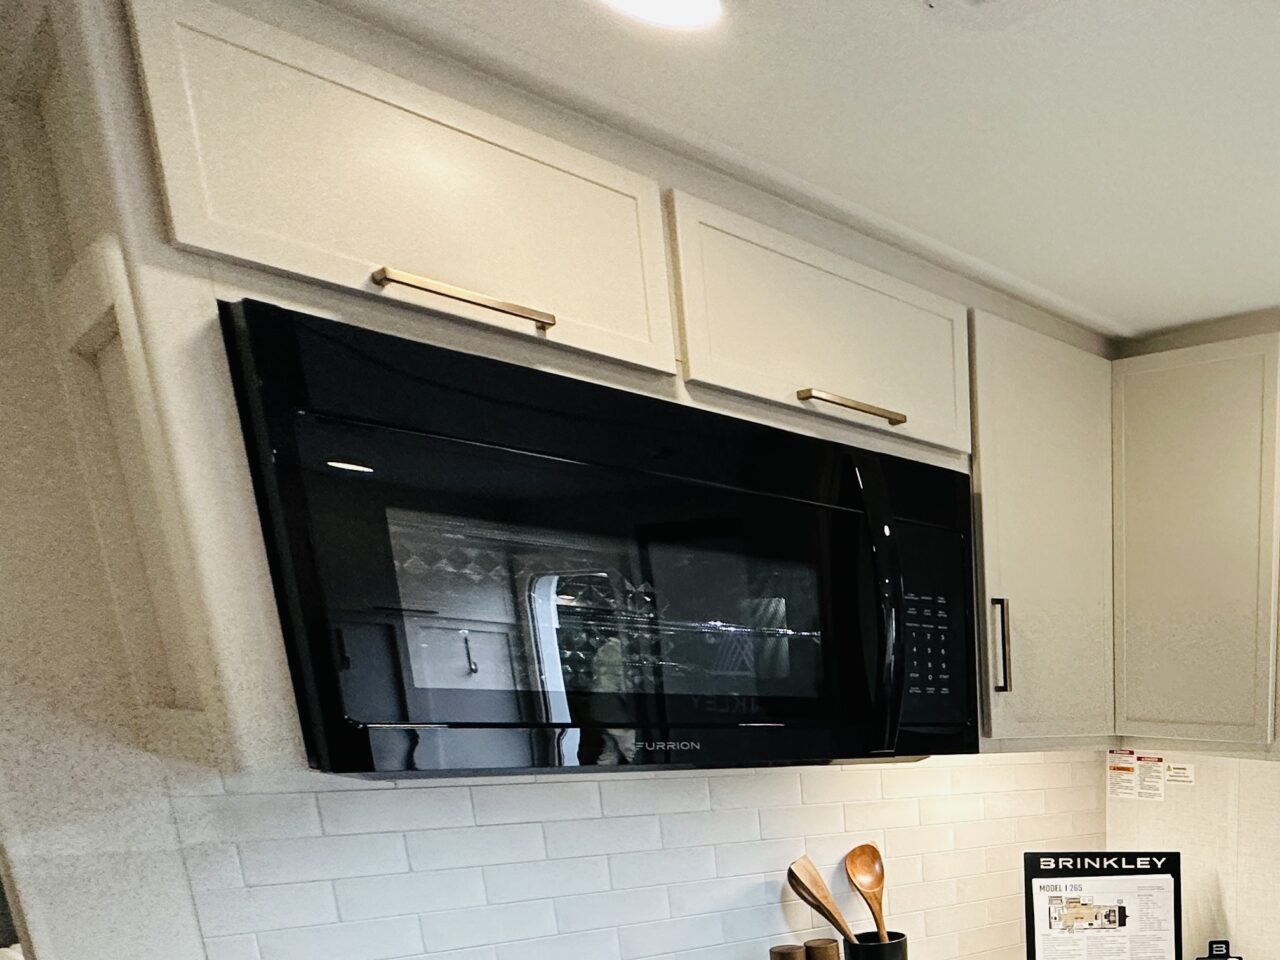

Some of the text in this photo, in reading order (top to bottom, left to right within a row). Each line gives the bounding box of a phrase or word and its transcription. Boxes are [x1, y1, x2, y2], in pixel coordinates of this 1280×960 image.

[635, 741, 701, 751] FURRION
[1039, 857, 1167, 869] BRINKLEY
[1039, 884, 1063, 892] MODEL
